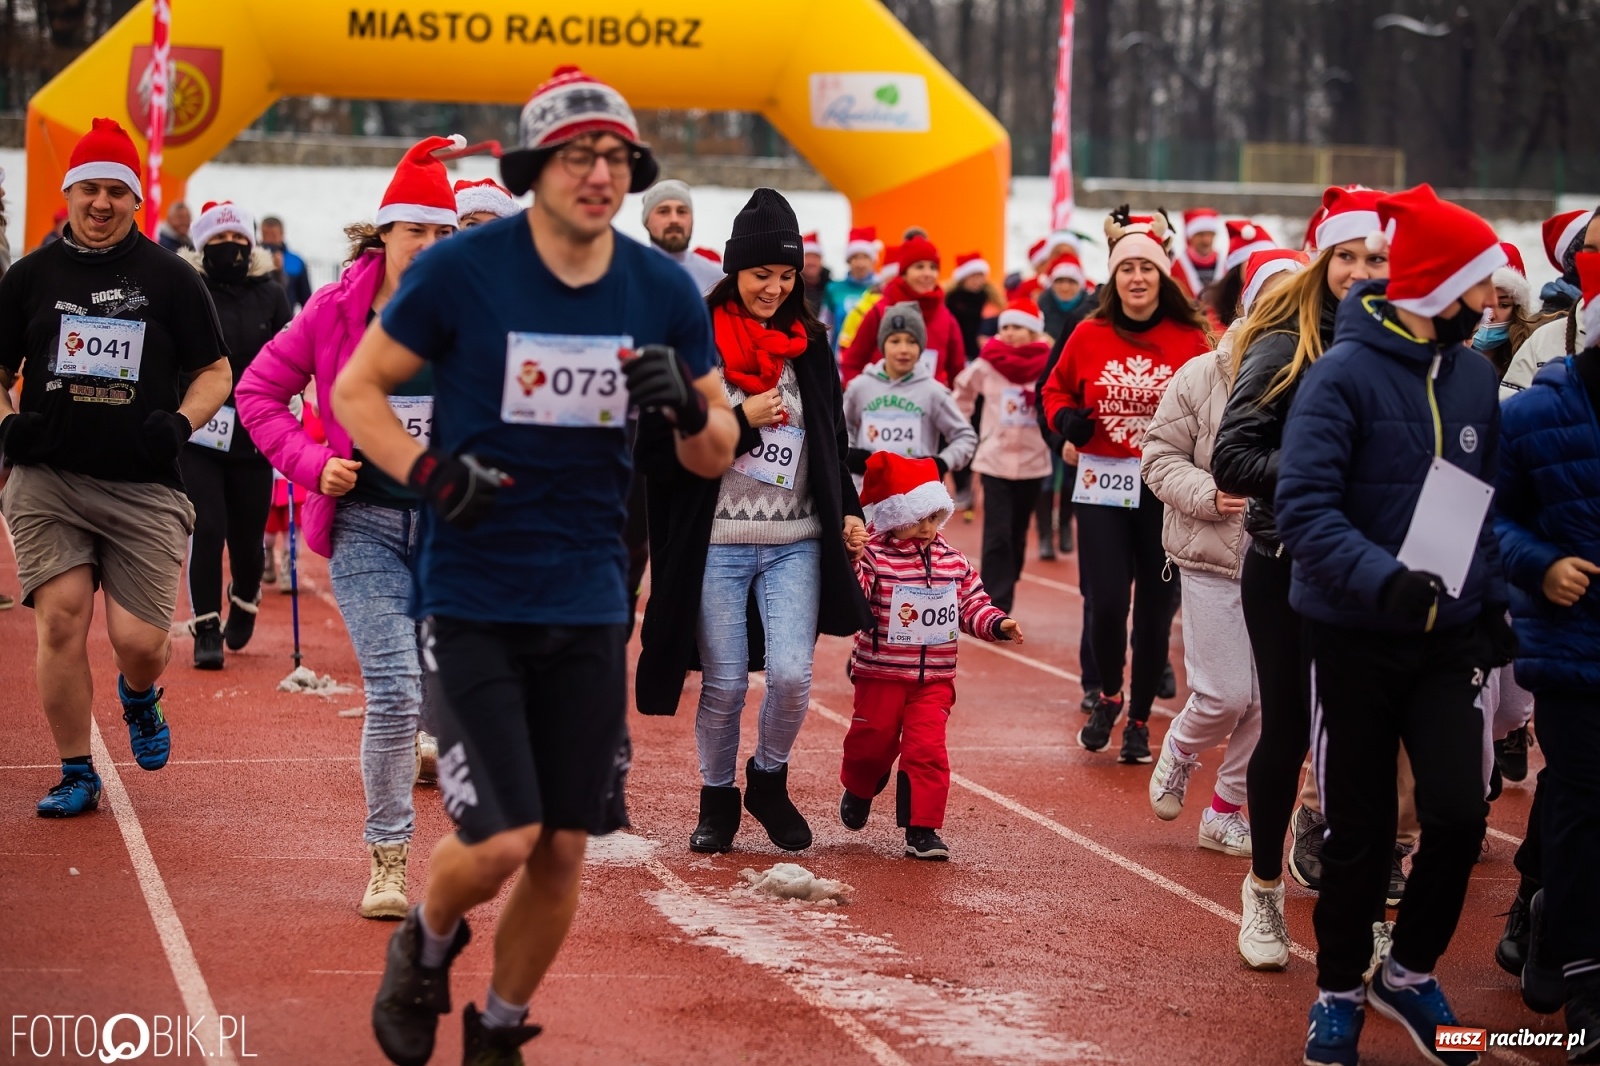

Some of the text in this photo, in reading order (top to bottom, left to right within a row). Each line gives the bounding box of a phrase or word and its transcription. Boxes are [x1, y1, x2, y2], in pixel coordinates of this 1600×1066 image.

[349, 9, 703, 48] MIASTO RACIBÓRZ
[91, 288, 124, 304] ROCK
[54, 300, 88, 316] REGGAE
[86, 336, 131, 359] 041
[552, 366, 617, 397] 073
[1106, 385, 1165, 402] HAPPY
[881, 427, 914, 442] 024
[748, 440, 793, 467] 089
[1099, 473, 1135, 492] 028
[921, 603, 956, 627] 086
